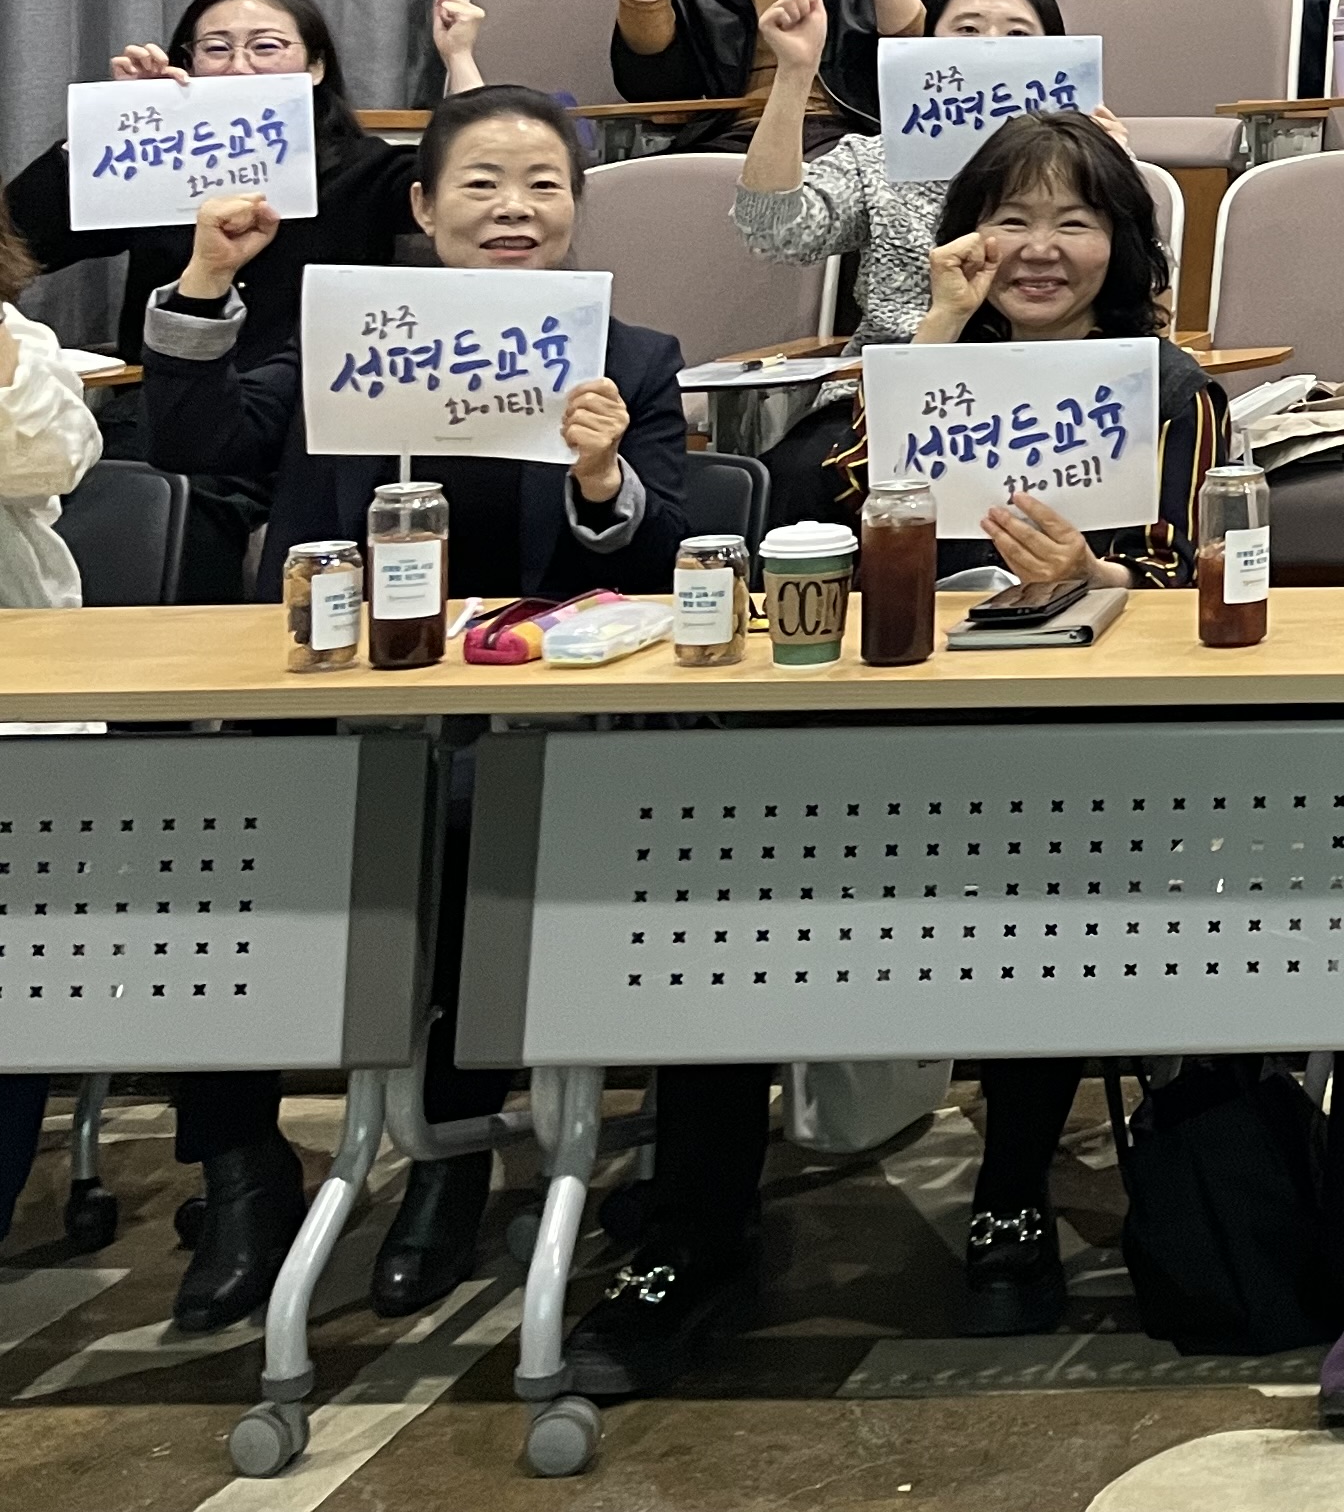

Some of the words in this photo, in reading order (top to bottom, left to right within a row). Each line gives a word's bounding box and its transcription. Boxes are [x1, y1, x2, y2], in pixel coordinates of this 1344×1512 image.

[923, 66, 964, 92] 광주
[119, 107, 163, 132] 광주
[93, 108, 287, 180] 성평등교육
[362, 305, 418, 339] 광주
[330, 316, 571, 398] 성평등교육
[922, 382, 976, 418] 광주
[894, 385, 1127, 479] 성평등교육
